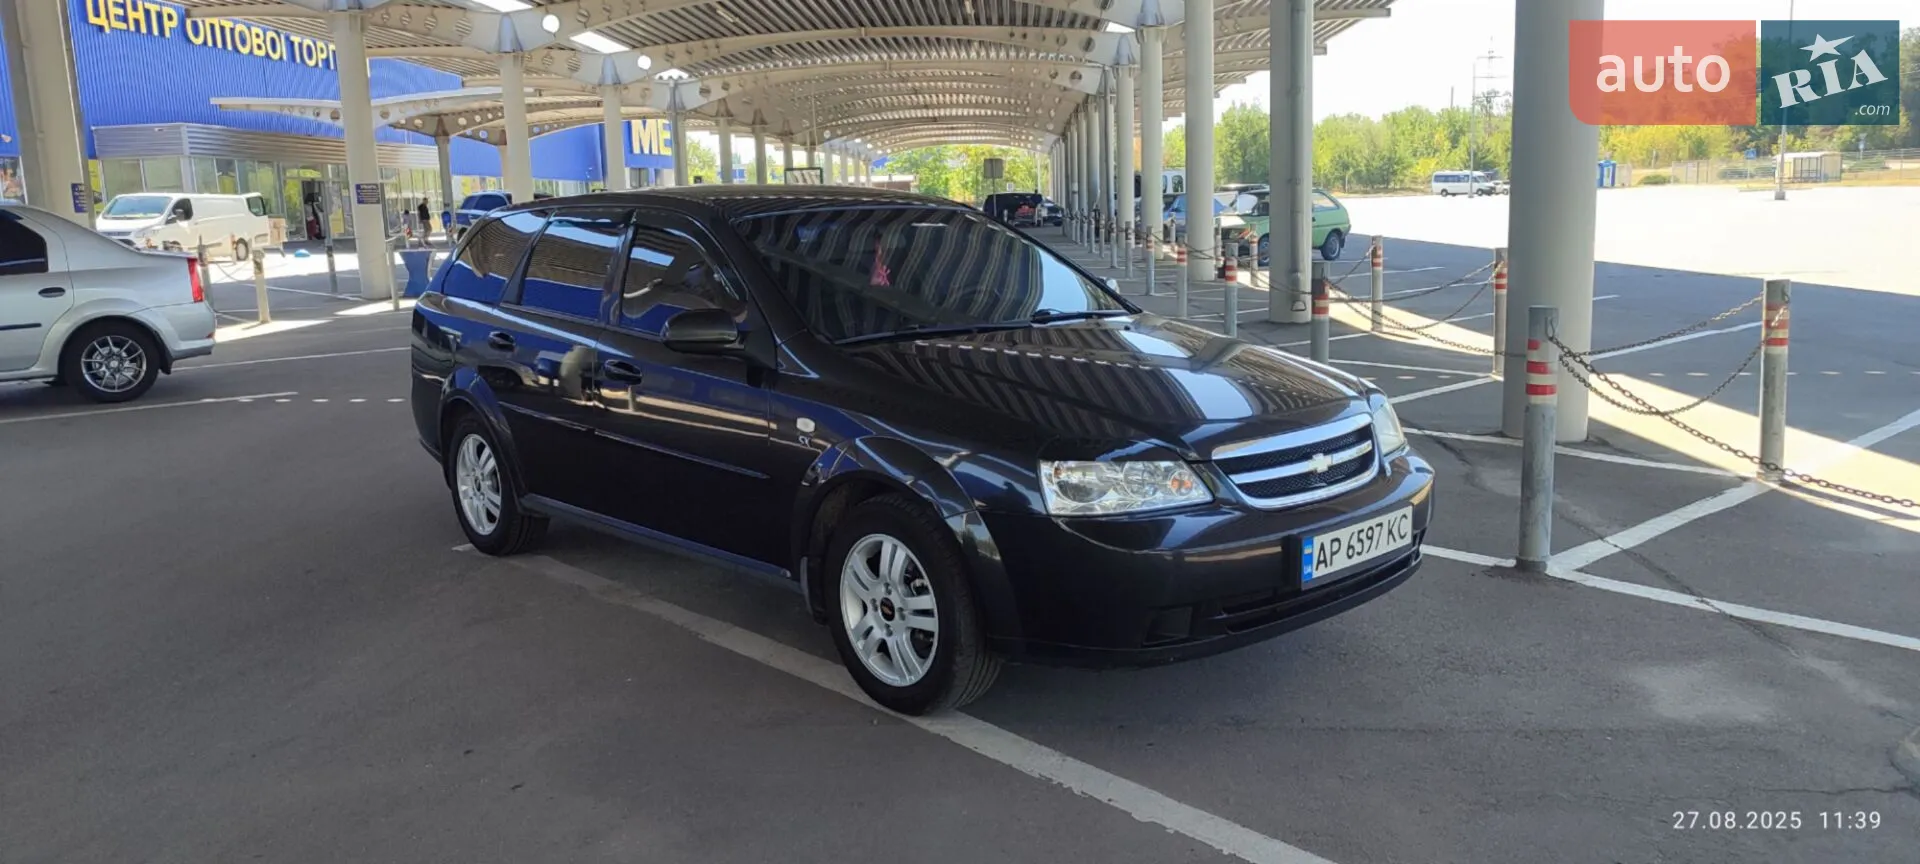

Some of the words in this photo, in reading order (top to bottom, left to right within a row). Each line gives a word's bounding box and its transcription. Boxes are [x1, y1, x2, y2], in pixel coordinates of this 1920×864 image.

[86, 0, 178, 38] ЦЕНТР
[1315, 537, 1342, 572] AP
[1346, 522, 1384, 560] 6597
[1387, 513, 1409, 546] KC
